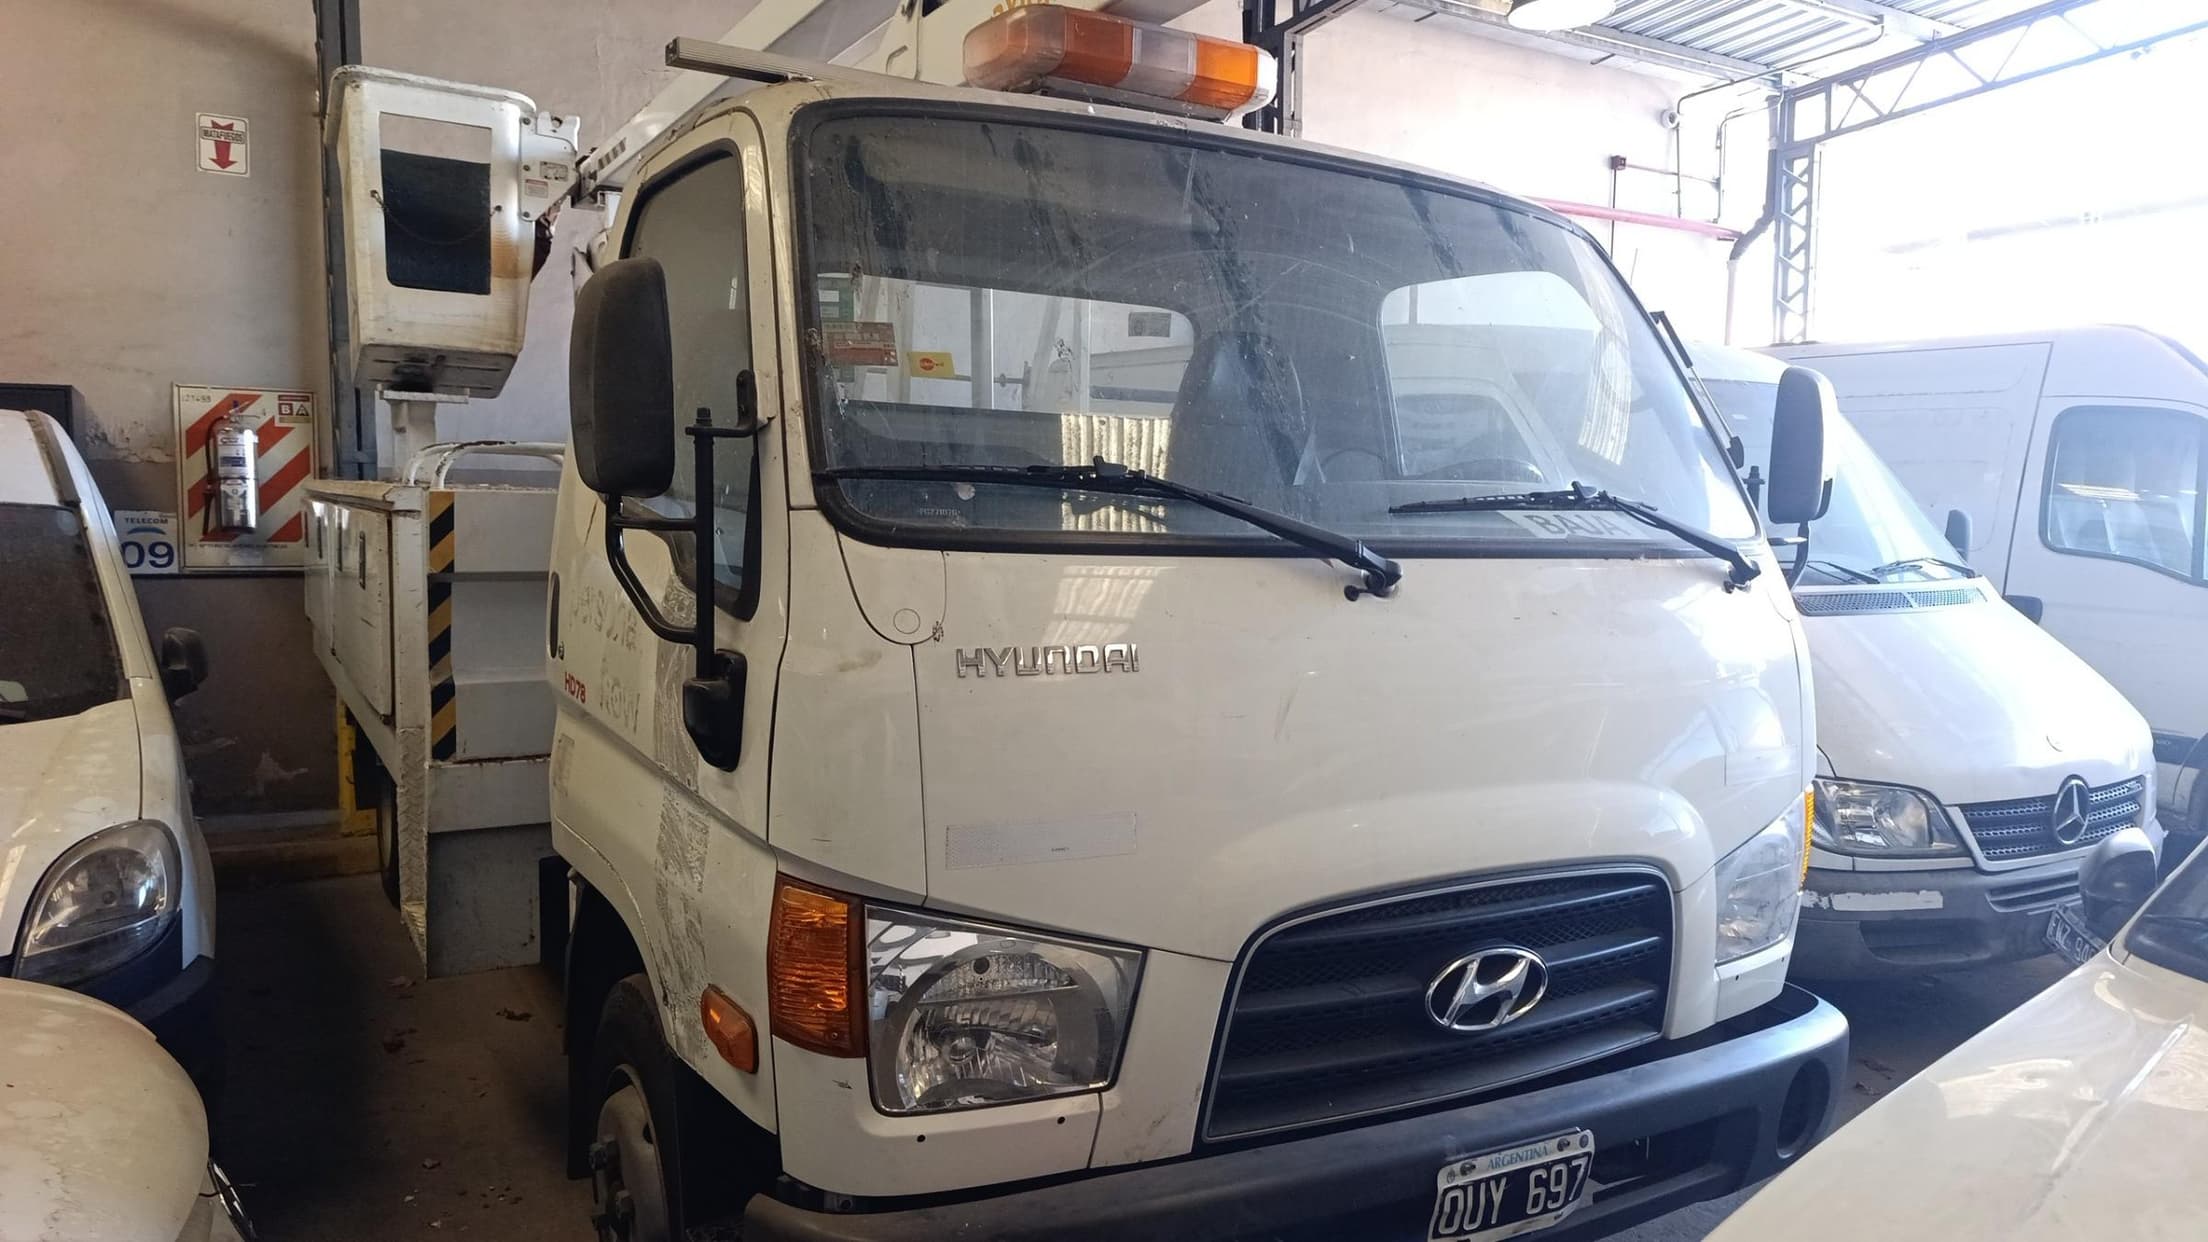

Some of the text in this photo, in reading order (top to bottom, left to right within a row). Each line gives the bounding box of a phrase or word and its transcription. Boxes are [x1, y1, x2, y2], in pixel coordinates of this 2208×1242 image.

[281, 404, 291, 415] B
[124, 517, 169, 525] TELECOM
[121, 541, 175, 568] 09
[956, 643, 1140, 678] HYUNDAI
[564, 671, 586, 704] HD78
[1487, 1145, 1549, 1170] ARGENTINA
[1438, 1156, 1589, 1235] OUY 697
